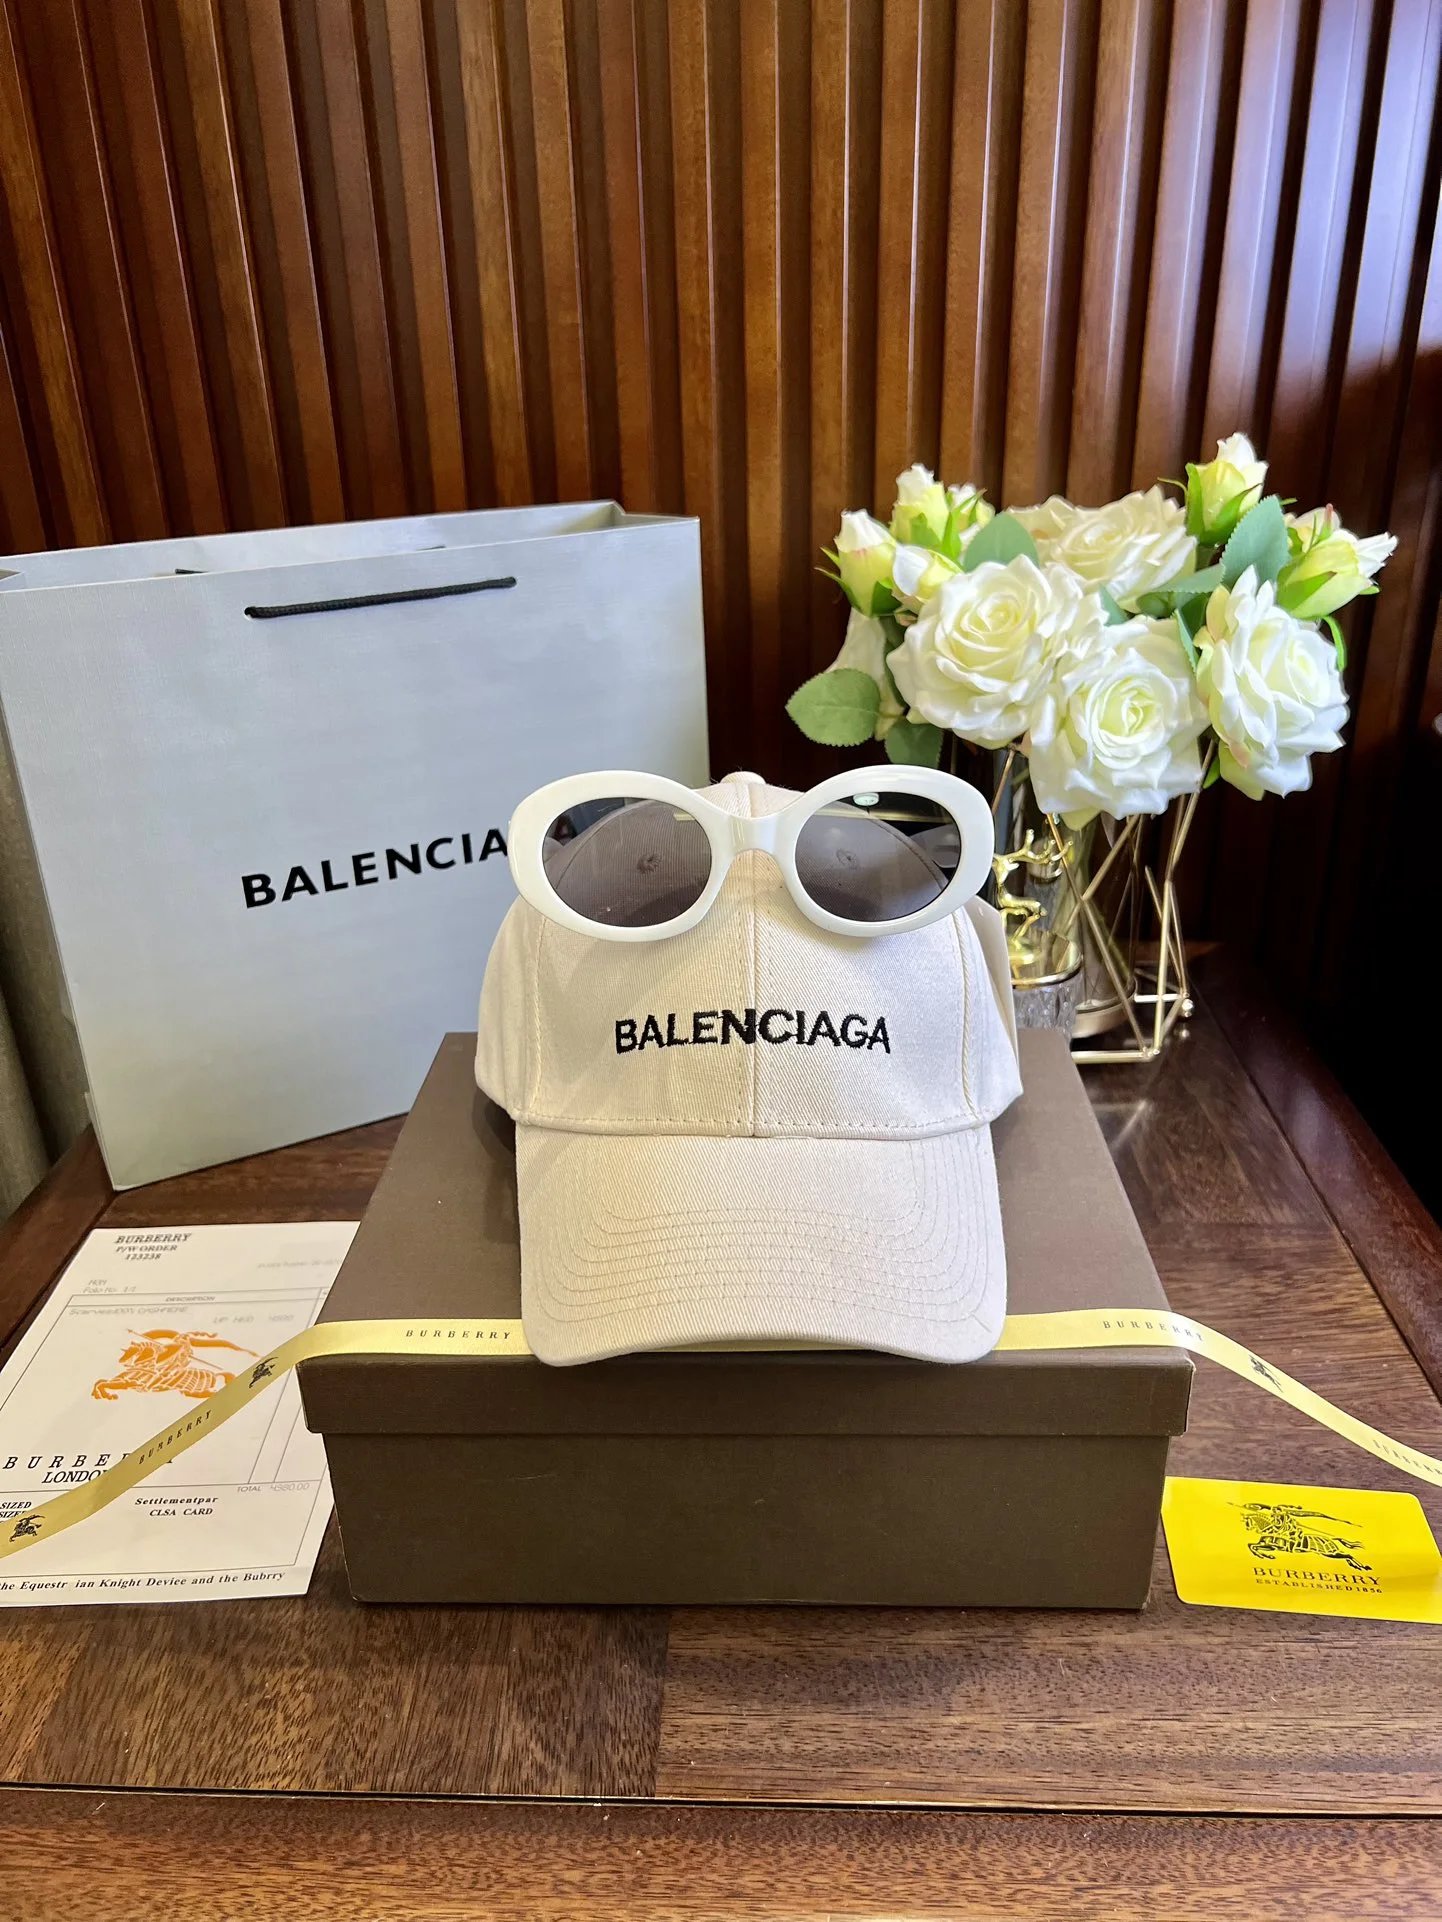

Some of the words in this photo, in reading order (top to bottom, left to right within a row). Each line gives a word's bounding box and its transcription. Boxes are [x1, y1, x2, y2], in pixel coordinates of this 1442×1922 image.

[615, 1008, 891, 1053] BALENCIAGA
[114, 1233, 191, 1244] BURBERRY
[405, 1329, 510, 1340] BURBERRY
[1103, 1321, 1203, 1341] BURBERRY
[139, 1410, 211, 1464] BURBERRY
[41, 1469, 107, 1483] LONDO
[134, 1496, 218, 1506] Settlementpar
[149, 1509, 176, 1517] CLSA
[183, 1508, 214, 1516] CARD
[19, 1580, 68, 1591] Equestr
[99, 1578, 141, 1588] Knight
[191, 1575, 214, 1585] and
[218, 1574, 238, 1583] the
[1253, 1567, 1380, 1586] BURBERRY
